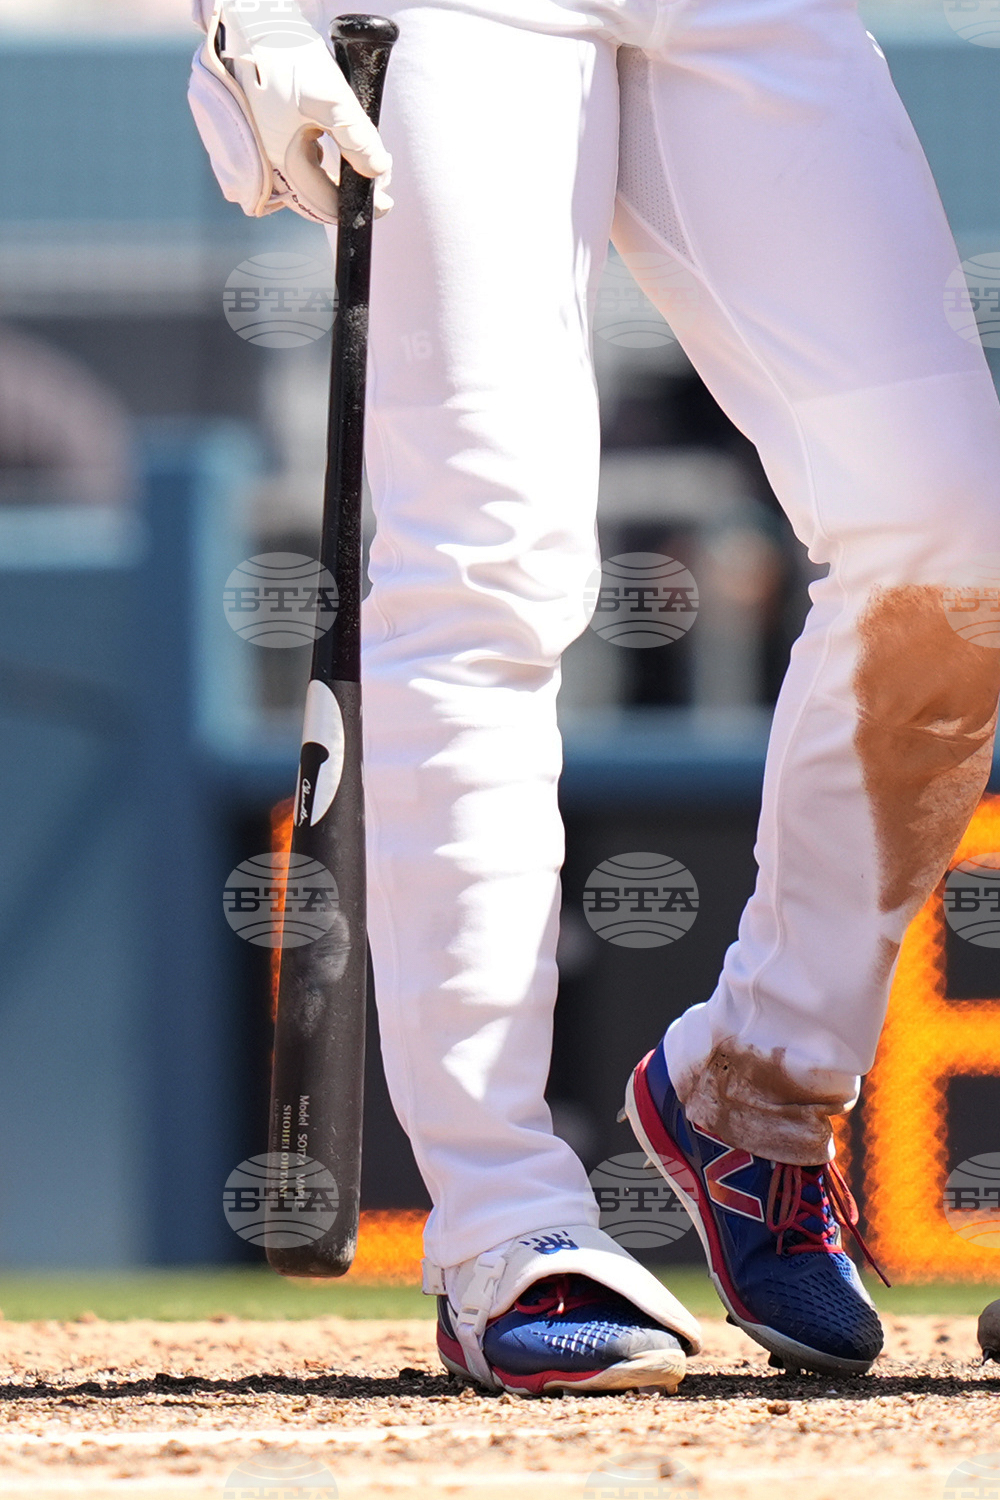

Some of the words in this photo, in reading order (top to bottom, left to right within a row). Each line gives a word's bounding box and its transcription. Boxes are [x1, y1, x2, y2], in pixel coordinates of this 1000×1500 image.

[281, 1104, 292, 1150] SHOHEI
[298, 1094, 310, 1126] Model
[279, 1152, 290, 1198] OHTANI
